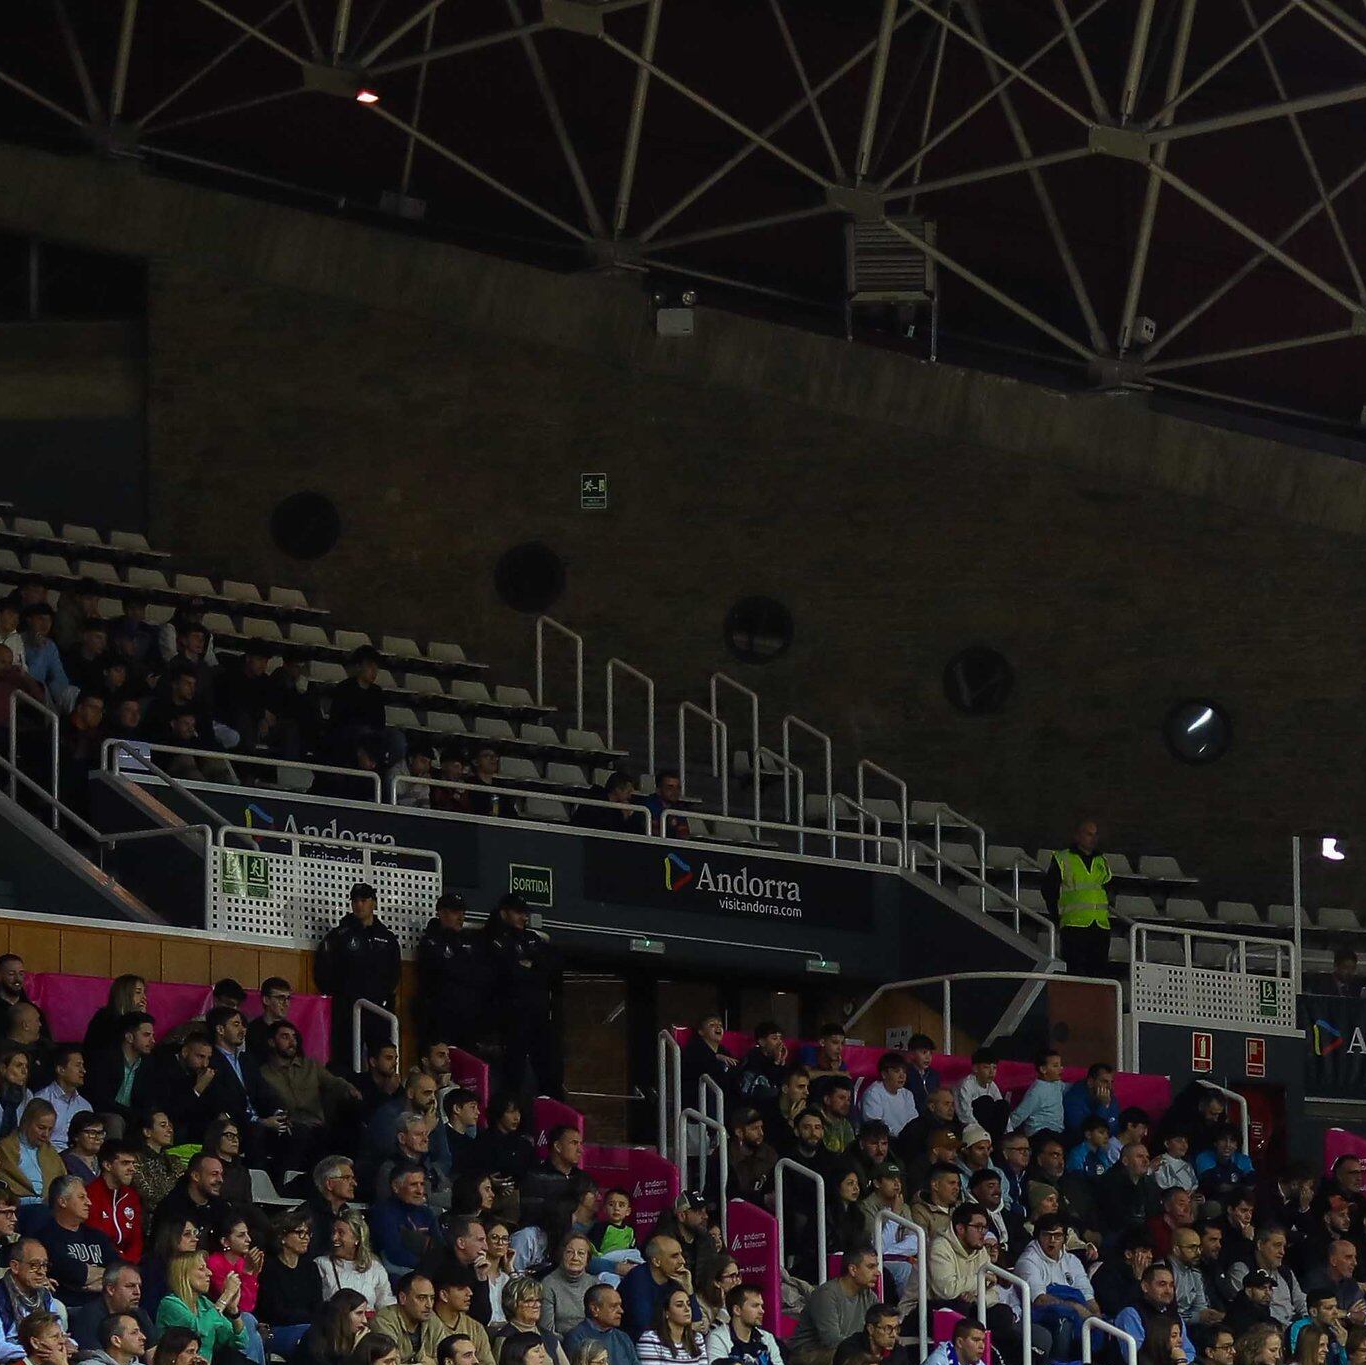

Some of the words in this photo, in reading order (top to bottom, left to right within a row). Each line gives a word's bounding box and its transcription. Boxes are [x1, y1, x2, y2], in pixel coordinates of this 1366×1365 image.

[513, 876, 550, 893] SORTIDA
[695, 862, 801, 902] Andorra
[719, 897, 803, 918] visitandorra.com
